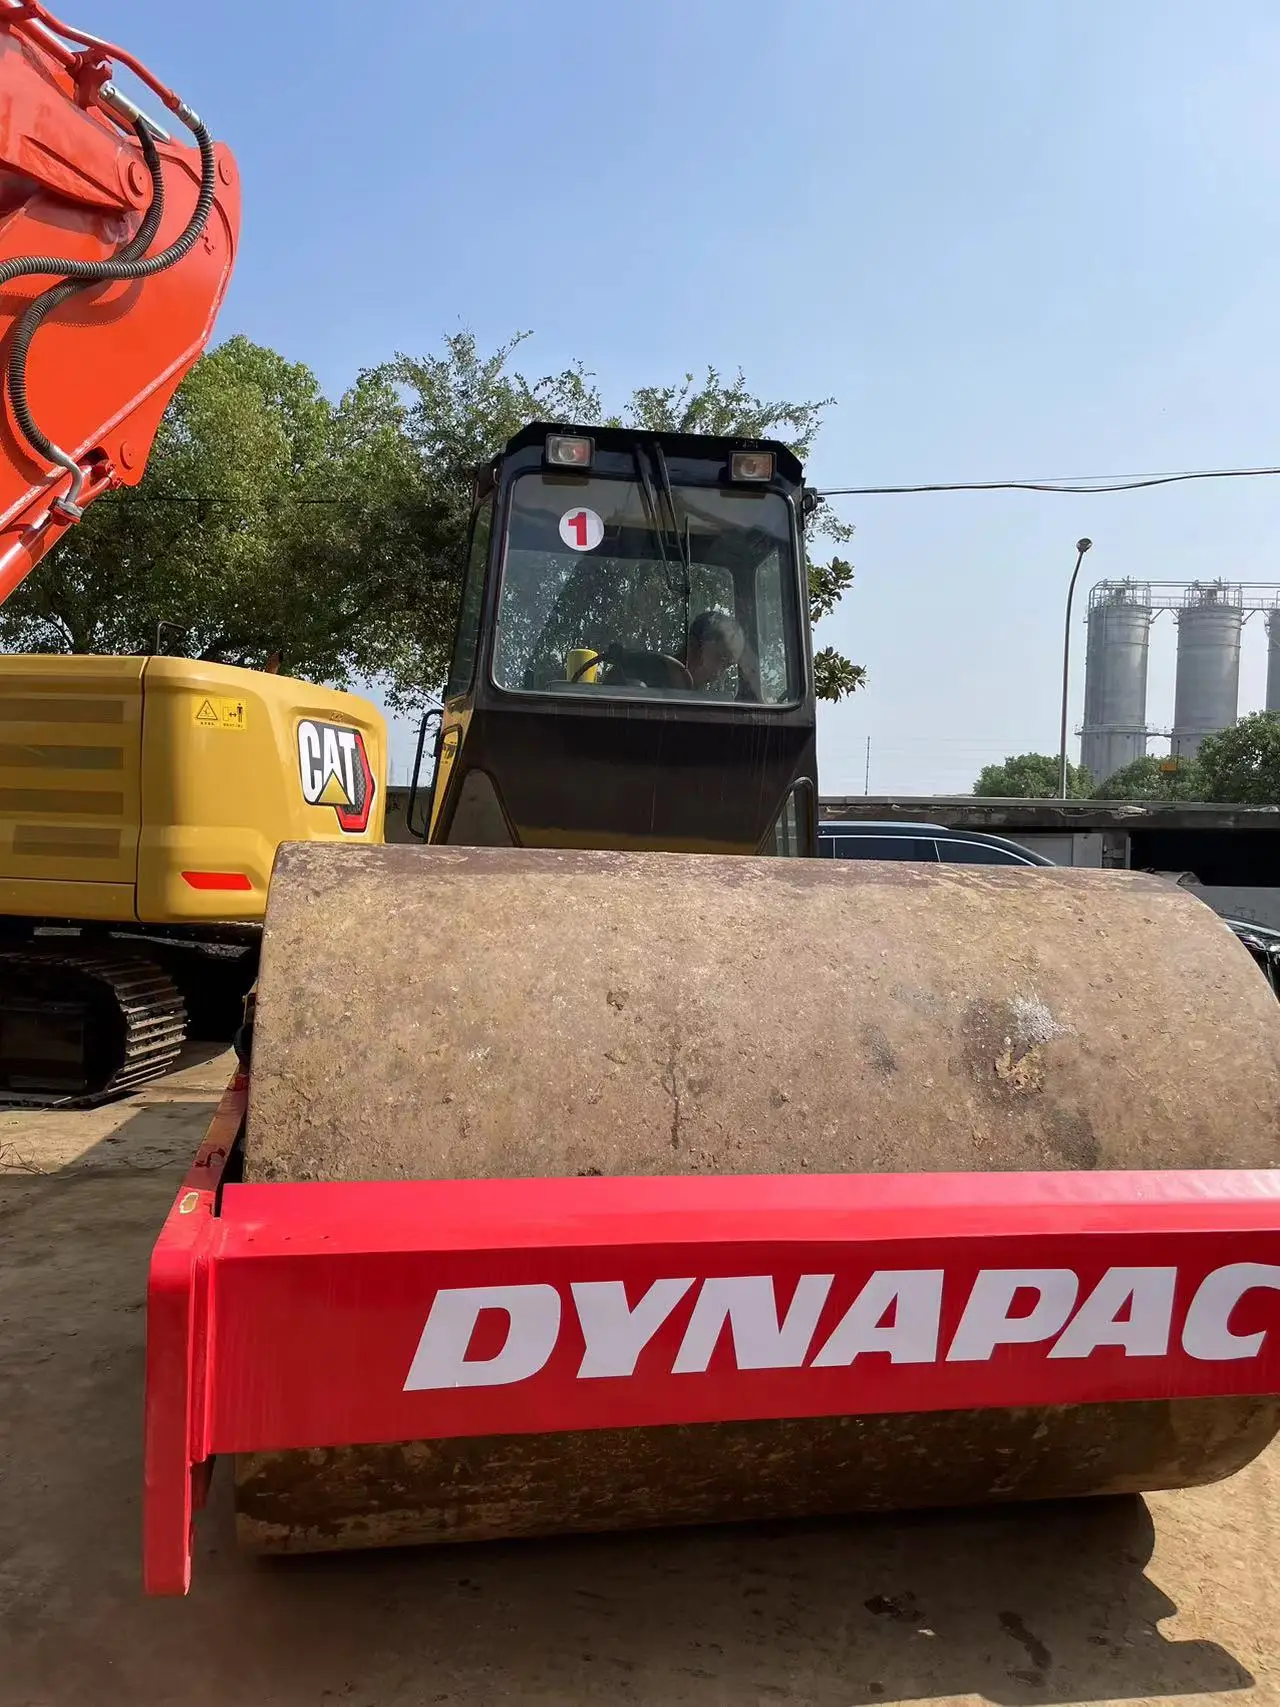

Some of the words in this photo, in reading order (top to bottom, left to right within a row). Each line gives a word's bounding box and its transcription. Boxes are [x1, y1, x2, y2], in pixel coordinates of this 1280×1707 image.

[568, 511, 587, 546] 1
[298, 721, 356, 805] CAT
[402, 1262, 1280, 1392] DYNAPAC
